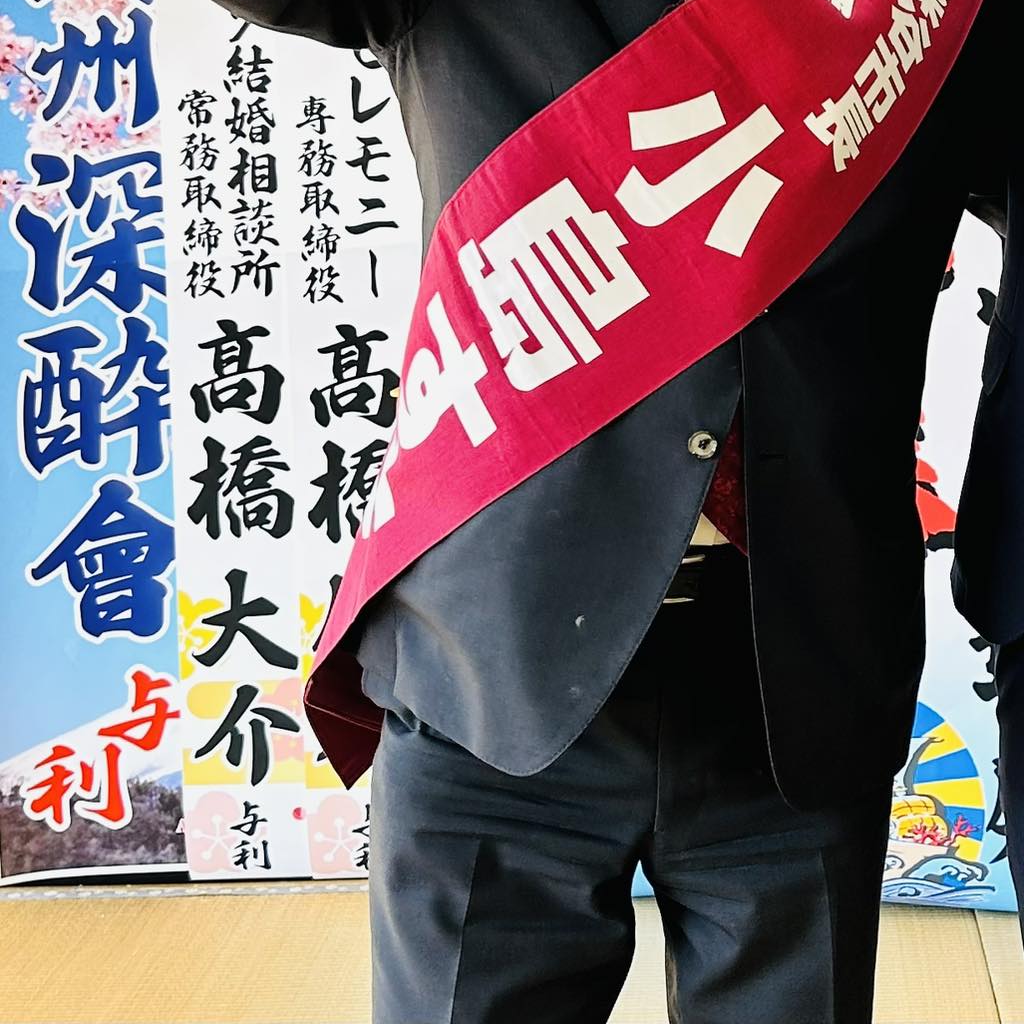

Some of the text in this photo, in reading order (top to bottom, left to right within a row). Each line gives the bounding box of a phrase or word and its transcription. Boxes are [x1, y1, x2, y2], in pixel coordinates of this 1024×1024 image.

[178, 88, 226, 300] 常務取締役
[296, 95, 344, 305] 専務取締役
[28, 671, 181, 824] 与利
[230, 800, 272, 871] 与利
